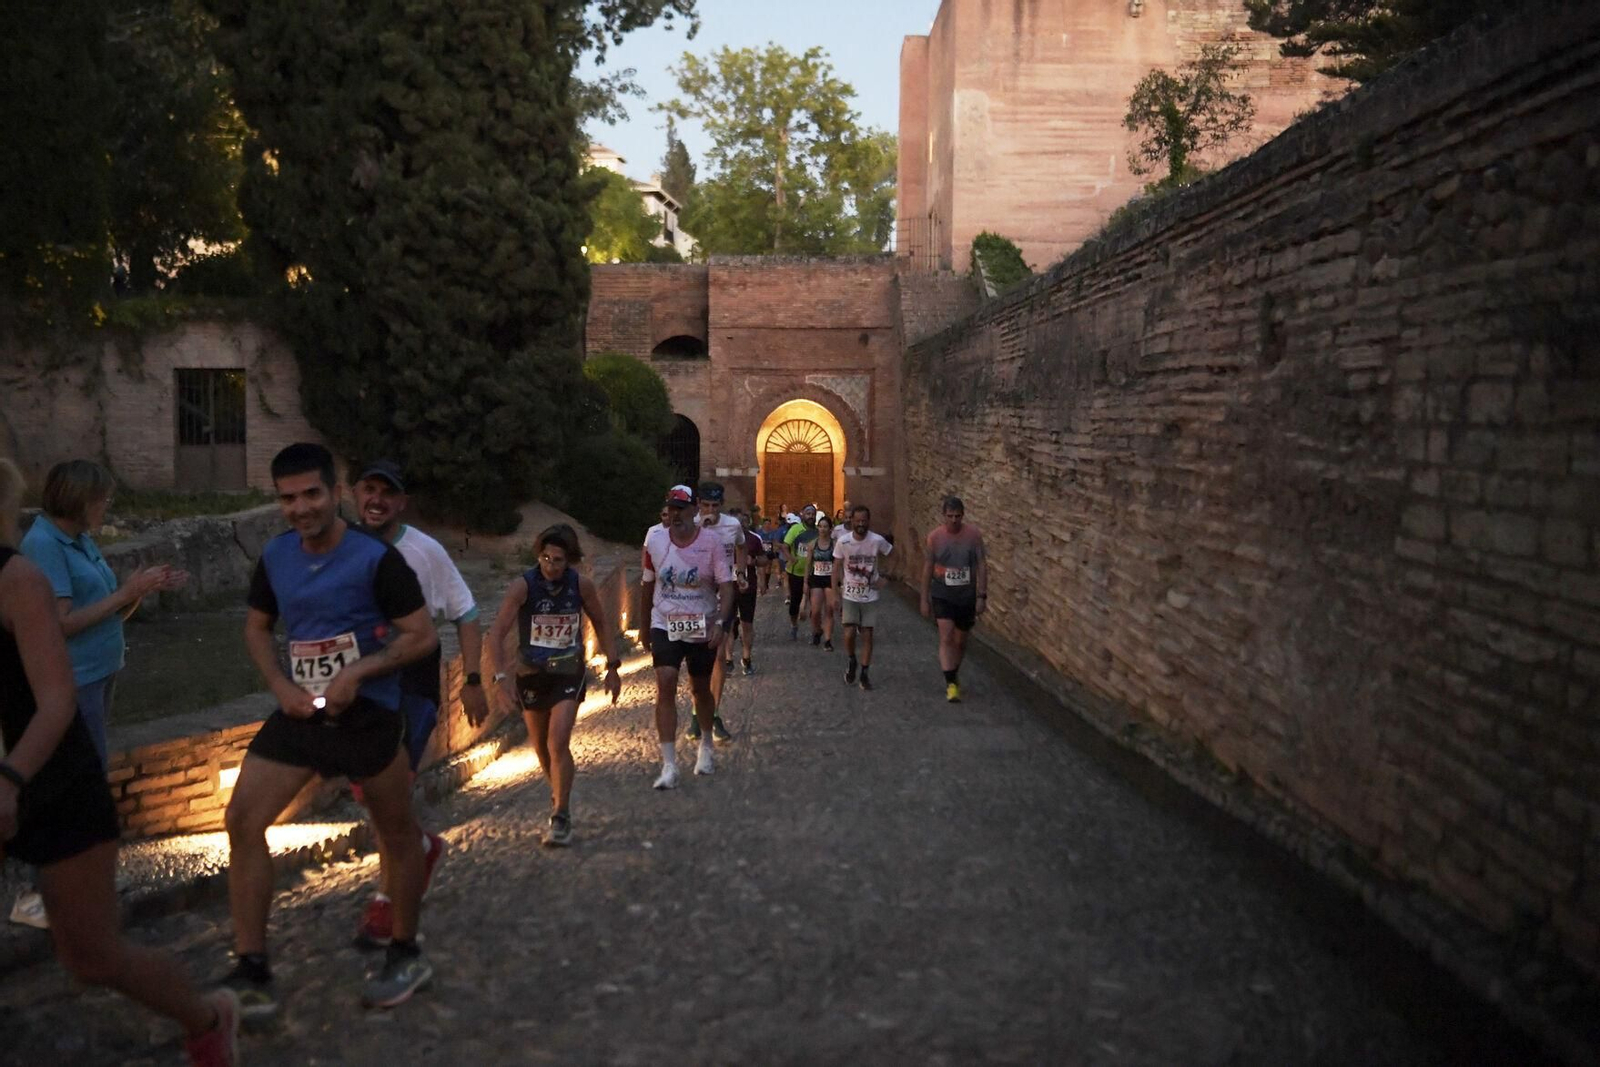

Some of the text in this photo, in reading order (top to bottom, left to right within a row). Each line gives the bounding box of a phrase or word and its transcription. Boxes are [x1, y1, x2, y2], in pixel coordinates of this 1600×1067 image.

[846, 585, 866, 594] 2737
[534, 625, 573, 638] 1374
[670, 621, 700, 632] 3935
[295, 652, 346, 679] 4751
